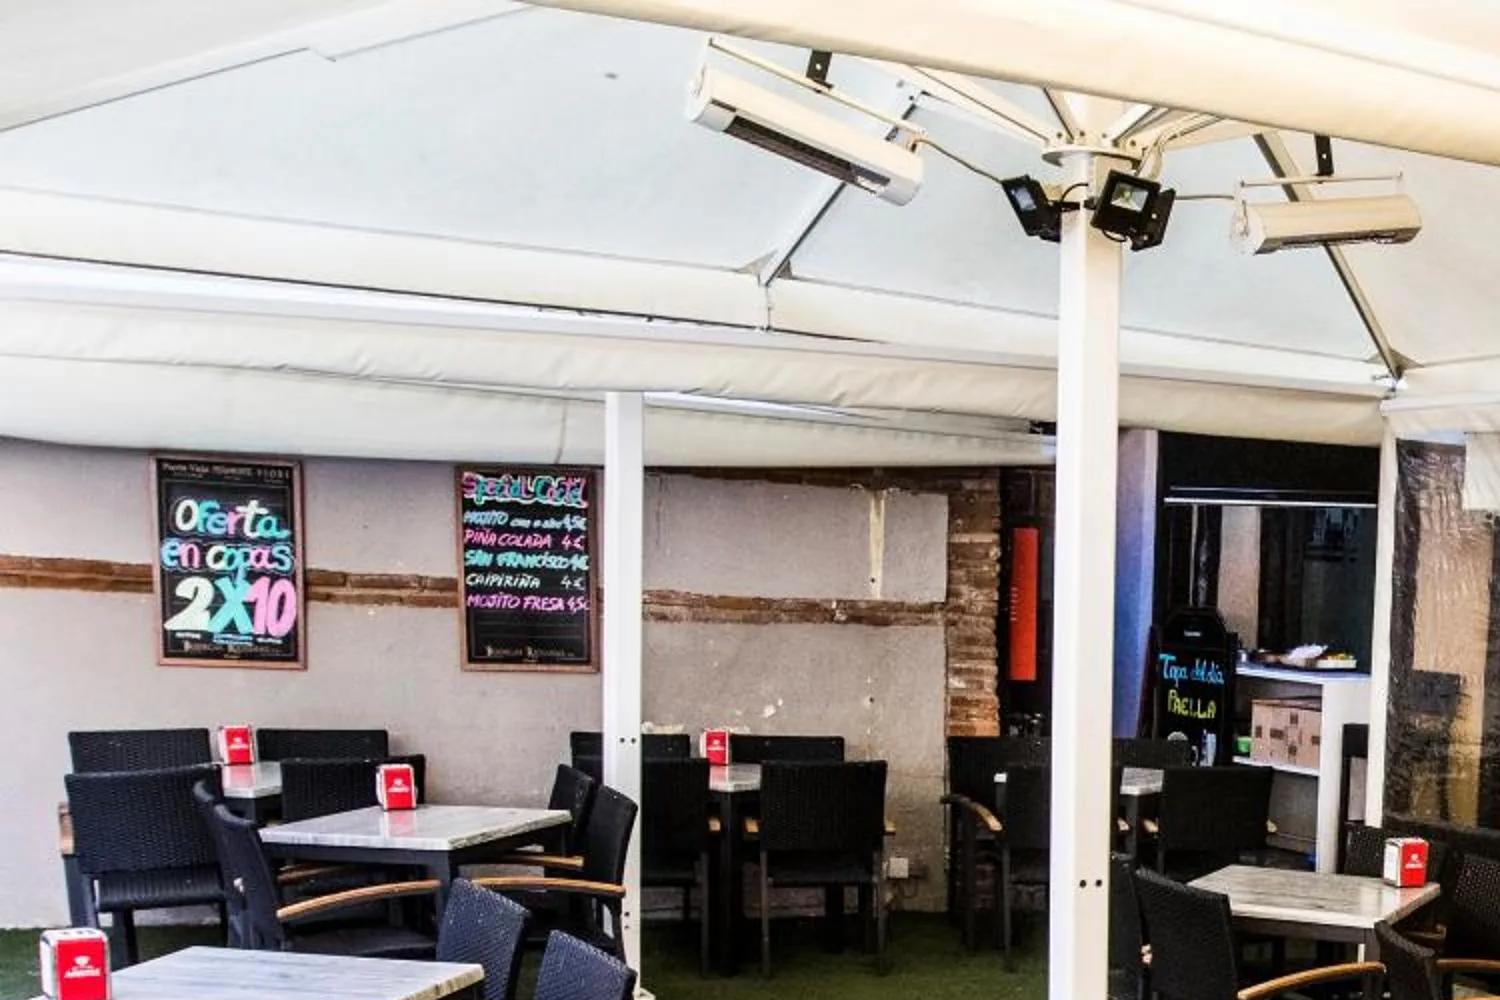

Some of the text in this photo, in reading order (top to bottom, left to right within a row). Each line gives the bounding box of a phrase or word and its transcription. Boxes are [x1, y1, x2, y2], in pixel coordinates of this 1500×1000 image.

[175, 499, 291, 539] Oferta
[464, 527, 496, 546] PIÑA
[498, 533, 552, 548] COLADA
[161, 539, 293, 580] en copas
[464, 549, 493, 566] SAN
[467, 592, 520, 609] MOJITO
[523, 595, 565, 611] FRESA
[1159, 653, 1188, 688] Tapa
